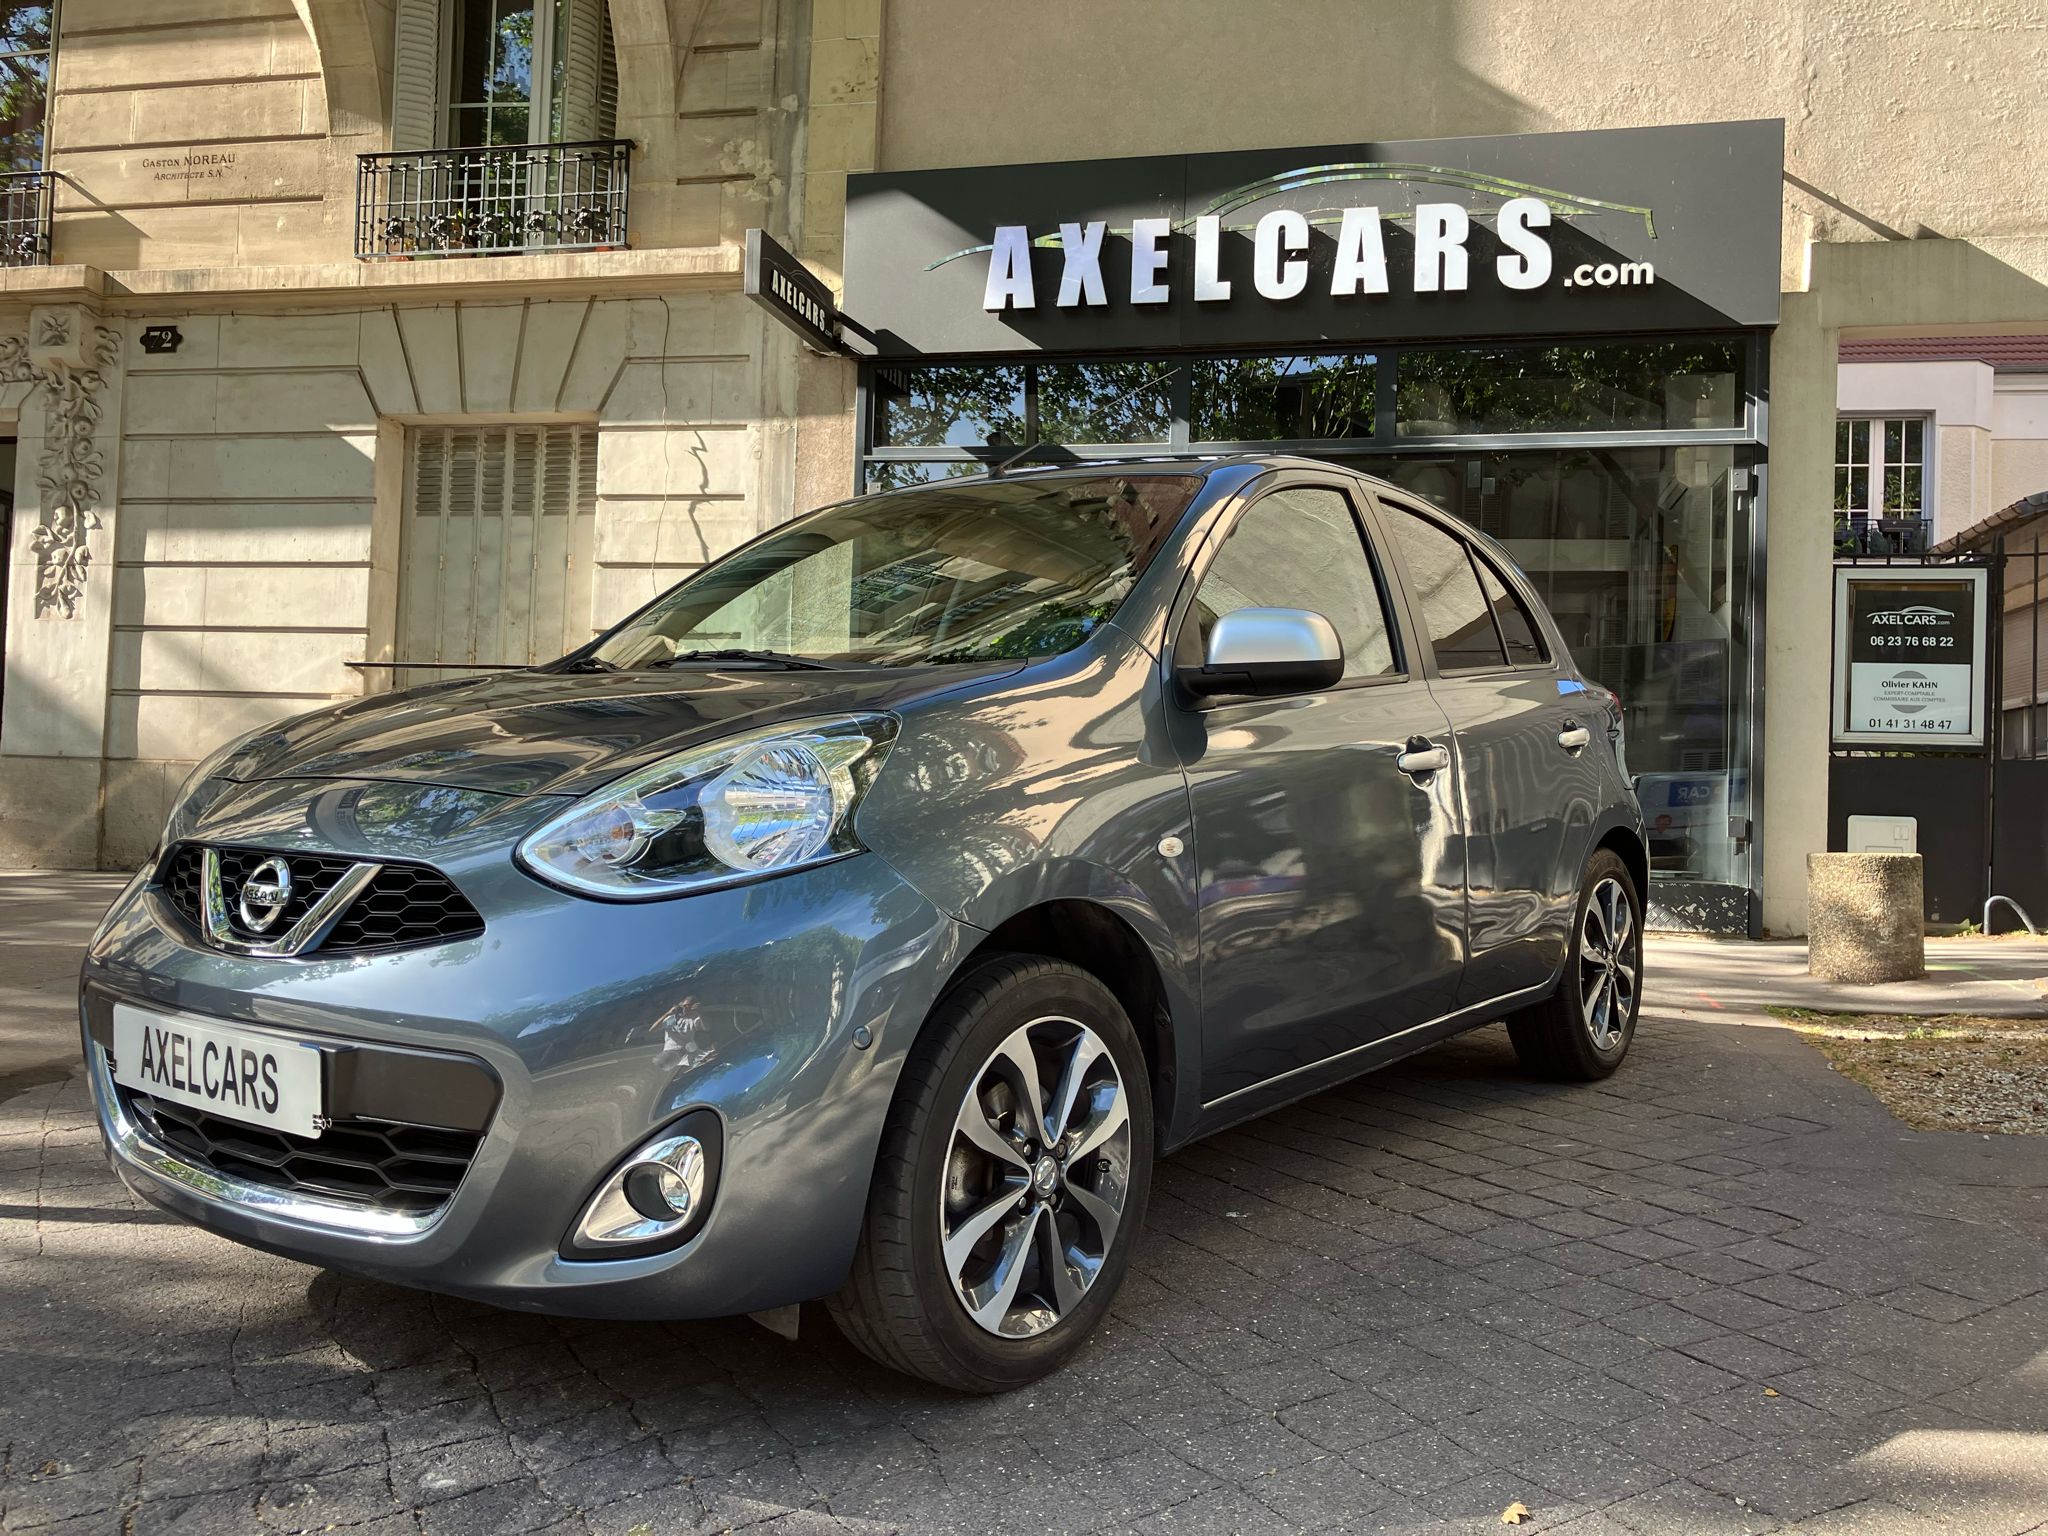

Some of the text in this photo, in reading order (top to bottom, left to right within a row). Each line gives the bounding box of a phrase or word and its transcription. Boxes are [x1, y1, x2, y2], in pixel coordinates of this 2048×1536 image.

[149, 330, 172, 348] 72
[1870, 636, 1954, 647] 06 23 76 68 22
[1881, 680, 1938, 689] Olivier KAHN
[1869, 718, 1952, 730] 01 41 31 48 47
[140, 1025, 280, 1115] AXELCARS
